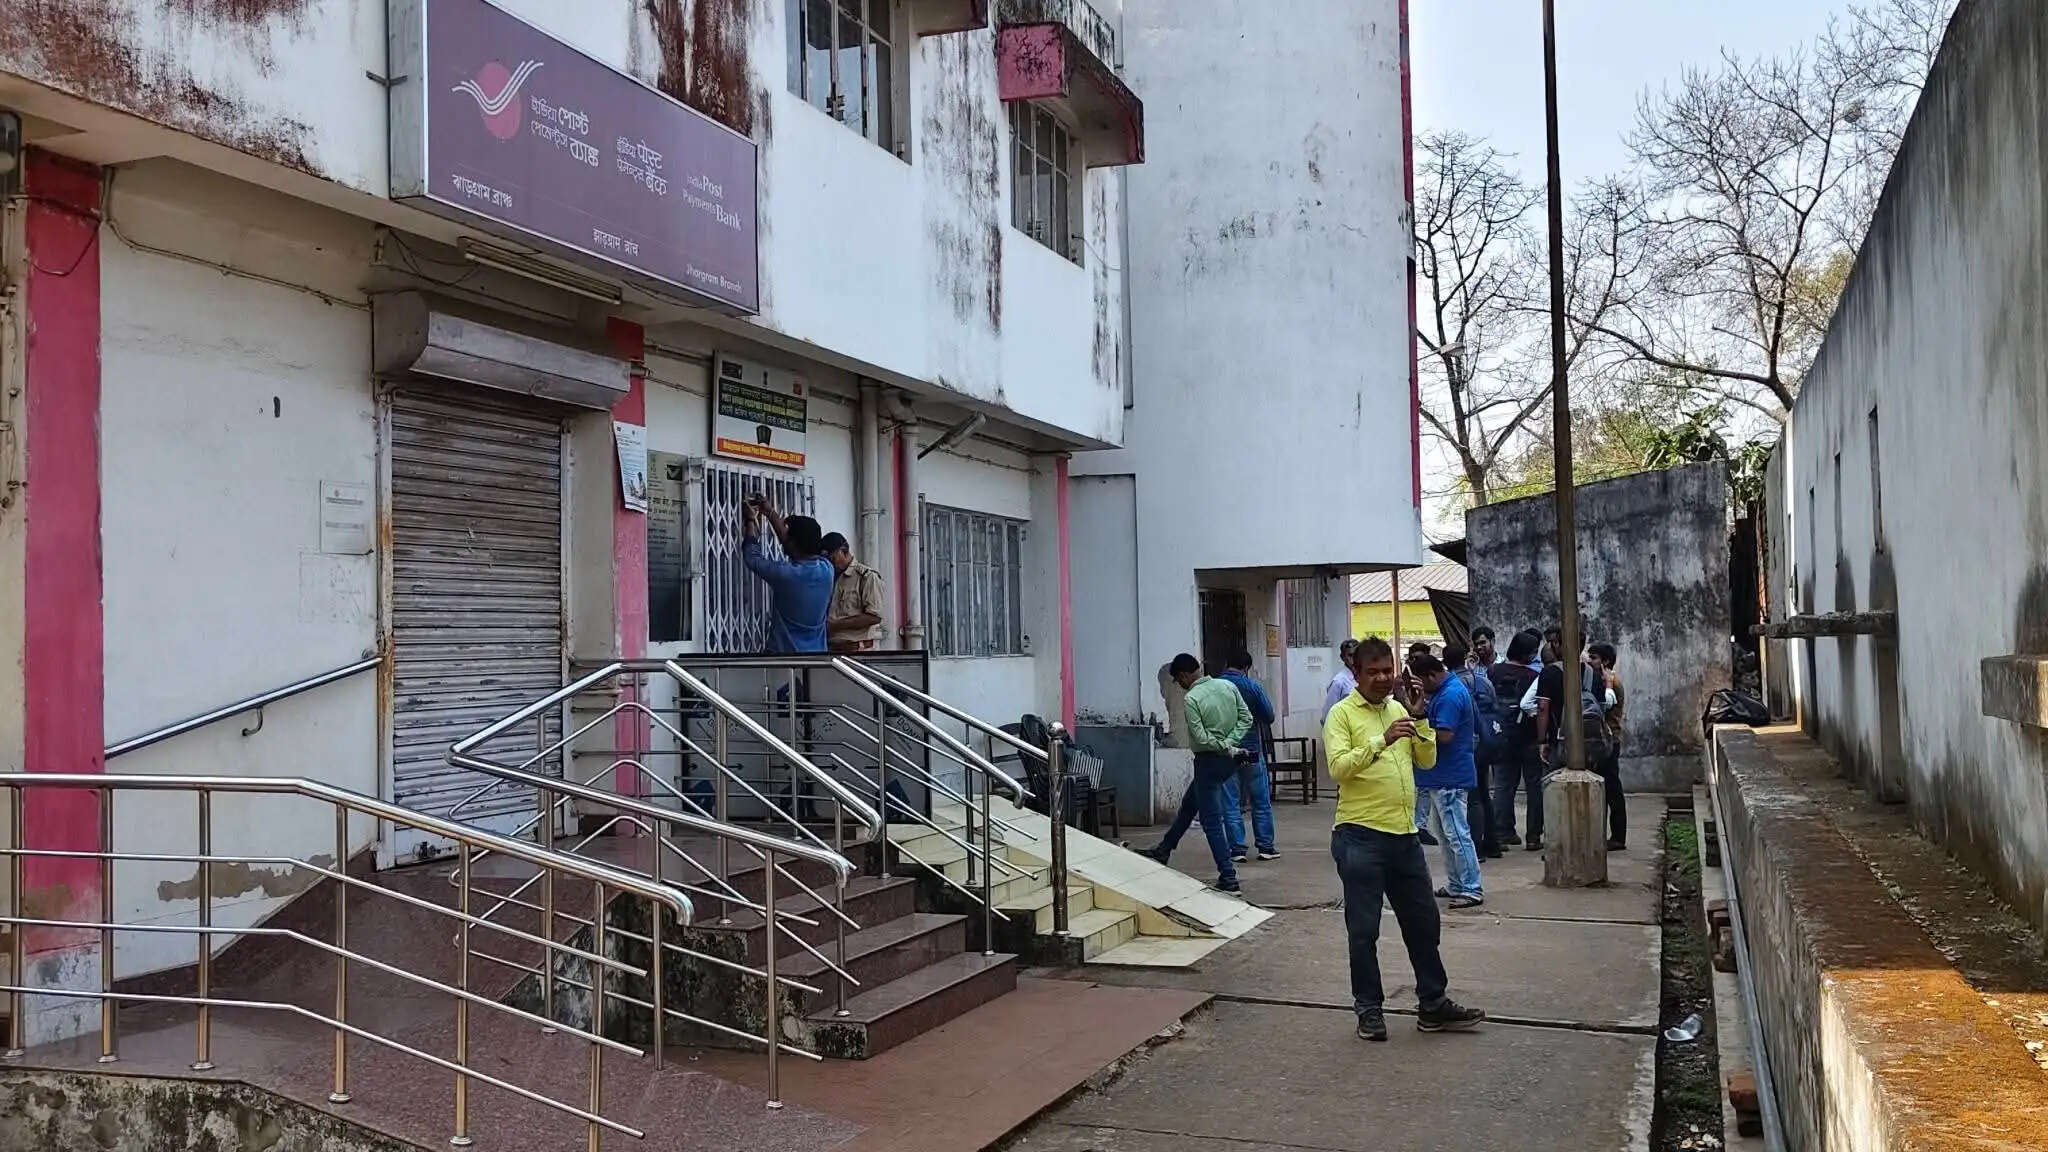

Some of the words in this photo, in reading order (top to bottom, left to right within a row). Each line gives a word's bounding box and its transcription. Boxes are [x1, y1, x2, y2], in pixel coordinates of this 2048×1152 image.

[637, 140, 664, 169] पोस्ट
[645, 165, 668, 196] बैंक
[702, 175, 723, 199] Post
[682, 189, 716, 215] Payments
[715, 205, 742, 231] Bank
[719, 274, 742, 294] Branch
